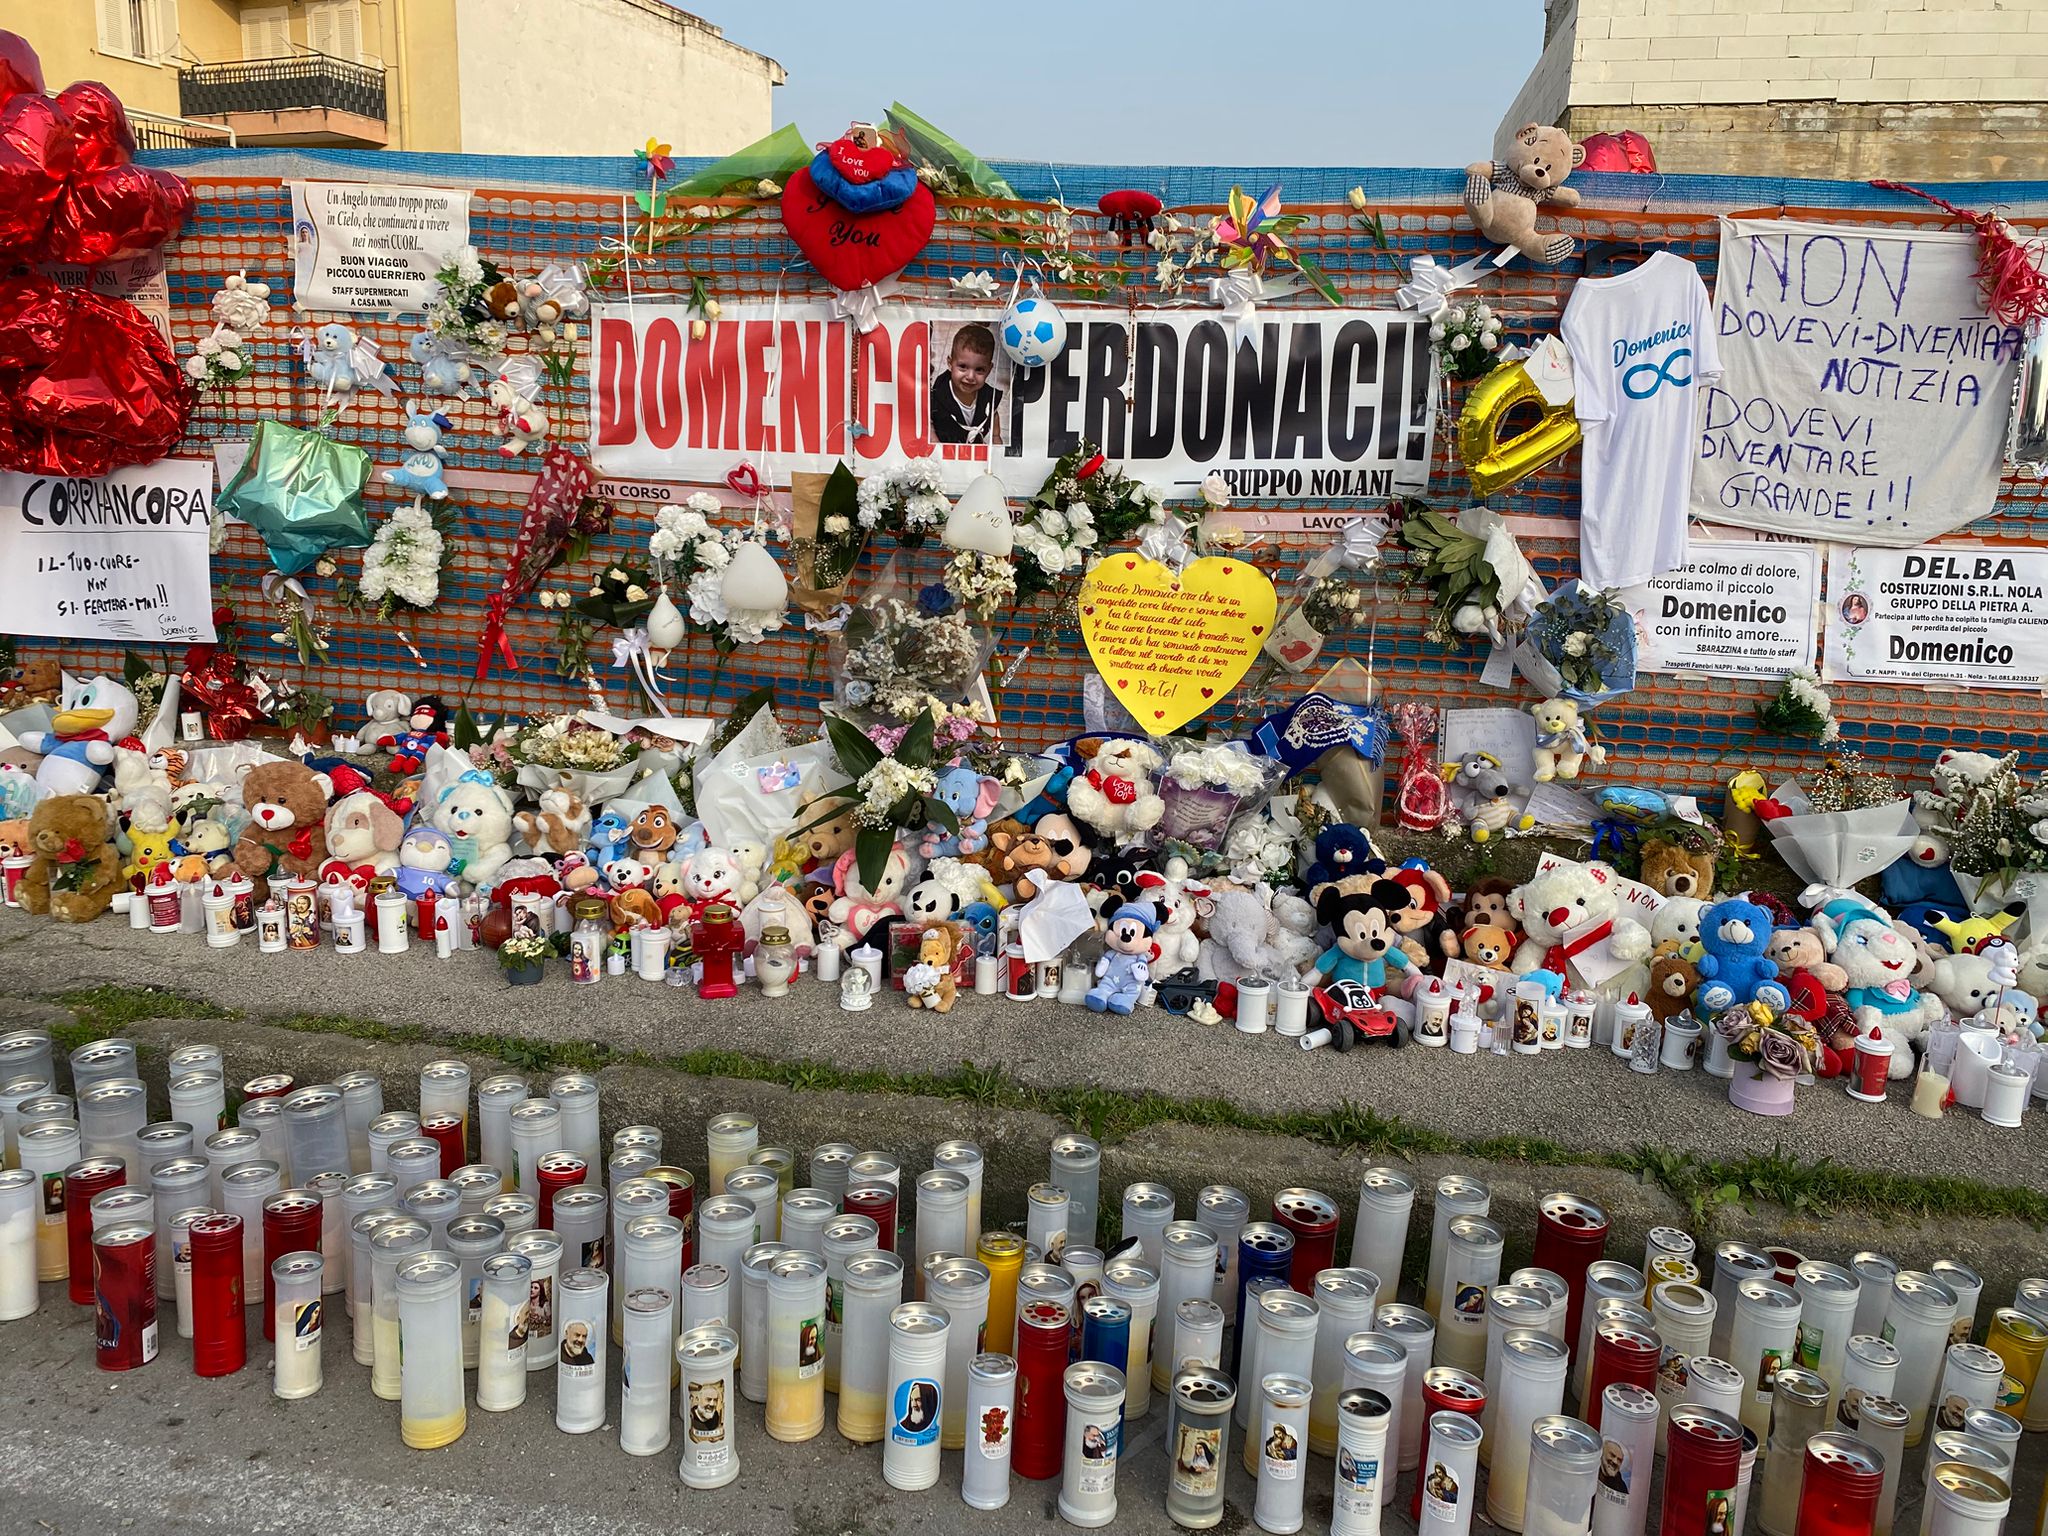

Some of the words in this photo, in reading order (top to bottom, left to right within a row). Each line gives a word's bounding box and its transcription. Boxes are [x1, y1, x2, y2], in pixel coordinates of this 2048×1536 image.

[838, 147, 844, 155] I
[842, 156, 864, 167] LOVE
[853, 168, 869, 177] YOU
[326, 189, 338, 205] Un
[340, 190, 368, 210] Angelo
[370, 193, 398, 208] tornato
[398, 195, 423, 211] troppo
[424, 197, 448, 214] presto
[327, 210, 336, 225] in
[337, 210, 362, 228] Cielo,
[362, 212, 378, 228] che
[378, 213, 417, 230] continuerà
[419, 220, 425, 230] a
[426, 216, 450, 232] vivere
[829, 220, 881, 247] You
[352, 233, 366, 248] nei
[368, 234, 390, 250] nostri
[390, 234, 424, 252] CUORI...
[340, 256, 366, 266] BUON
[368, 256, 408, 268] VIAGGIO
[326, 268, 366, 278] PICCOLO
[367, 269, 426, 281] GUERRIERO
[1746, 233, 1915, 317] NON
[332, 286, 354, 296] STAFF
[354, 287, 408, 298] SUPERMERCATI
[350, 298, 356, 306] A
[357, 298, 376, 307] CASA
[378, 298, 392, 307] MIA
[597, 316, 988, 462] DOMENICO...
[1004, 319, 1432, 464] PERDONACI!
[1704, 387, 1873, 446] DOVEVI
[1702, 433, 1878, 477] DIVENTARE
[1310, 468, 1394, 497] NOLANI
[597, 484, 614, 496] IN
[620, 486, 670, 500] CORSO
[1699, 562, 1738, 575] colmo
[1740, 563, 1752, 576] di
[1756, 564, 1800, 580] dolore,
[1903, 555, 2016, 581] DEL.BA
[1097, 580, 1128, 594] Piccolo
[1132, 584, 1178, 599] Domenico
[1199, 591, 1214, 602] che
[1648, 576, 1713, 592] ricordiamo
[1716, 580, 1724, 592] il
[1728, 580, 1774, 596] piccolo
[1880, 582, 1964, 597] COSTRUZIONI
[1966, 585, 2004, 598] S.R.L.
[2007, 586, 2043, 599] NOLA
[1662, 595, 1787, 624] Domenico
[1891, 598, 1938, 610] GRUPPO
[1942, 599, 1976, 611] DELLA
[1980, 601, 2018, 612] PIETRA
[2021, 602, 2033, 613] A.
[1955, 615, 1979, 624] colpito
[1989, 617, 2016, 626] famiglia
[1655, 626, 1680, 636] con
[1684, 624, 1732, 640] infinito
[1963, 626, 1988, 634] piccolo
[1130, 635, 1143, 646] che
[1696, 644, 1742, 654] SBARAZZINA
[1750, 646, 1768, 656] tutto
[1768, 648, 1776, 656] lo
[1777, 648, 1797, 657] staff
[1890, 634, 2014, 665] Domenico
[1922, 671, 1950, 679] Cipressi
[1137, 679, 1156, 696] Per
[1114, 788, 1128, 800] YOU
[422, 876, 434, 886] 10
[1626, 887, 1660, 912] NON
